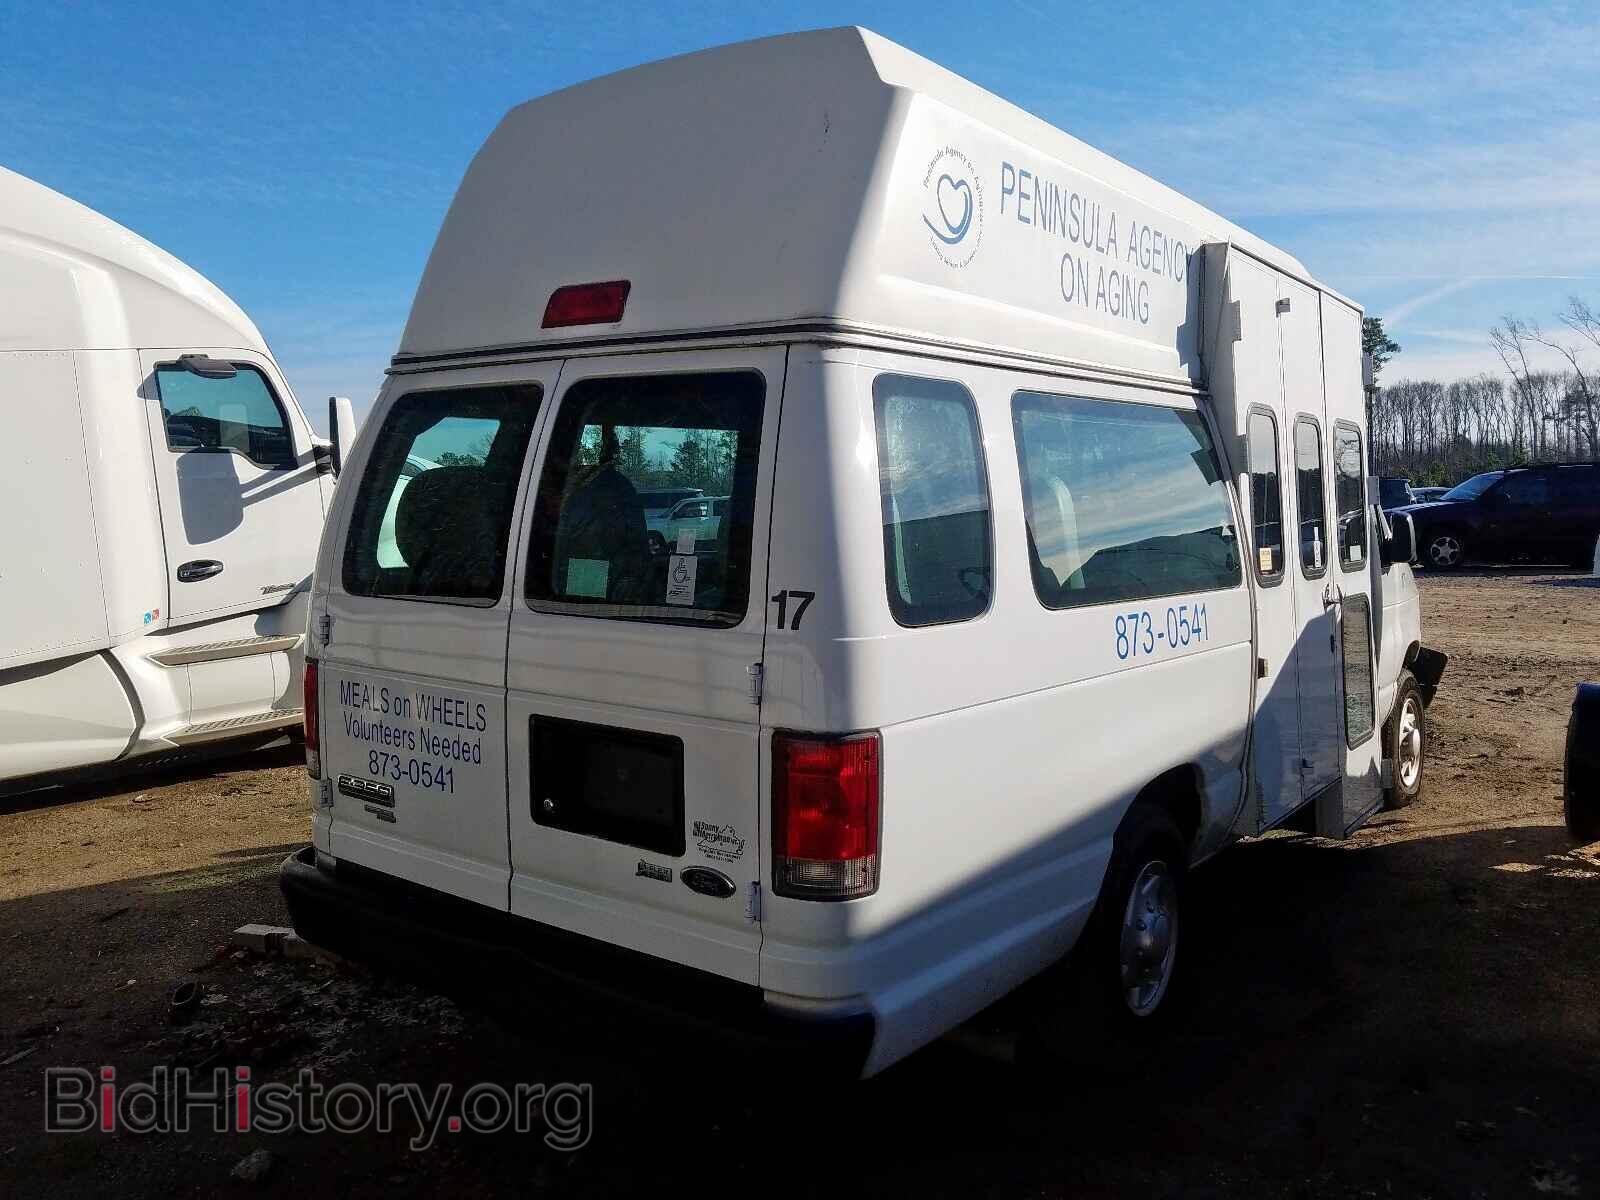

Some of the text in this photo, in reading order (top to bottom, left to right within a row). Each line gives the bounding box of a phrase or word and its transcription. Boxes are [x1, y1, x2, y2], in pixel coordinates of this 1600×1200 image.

[1000, 160, 1119, 260] PENINSULA
[1127, 220, 1195, 283] AGENCY
[1060, 252, 1150, 325] ON AGING
[771, 589, 816, 631] 17
[1114, 603, 1209, 660] 873-0541
[340, 680, 487, 732] MEALS on WHEELS
[343, 711, 482, 765] Volunteers Needed
[368, 749, 454, 794] 873-0541
